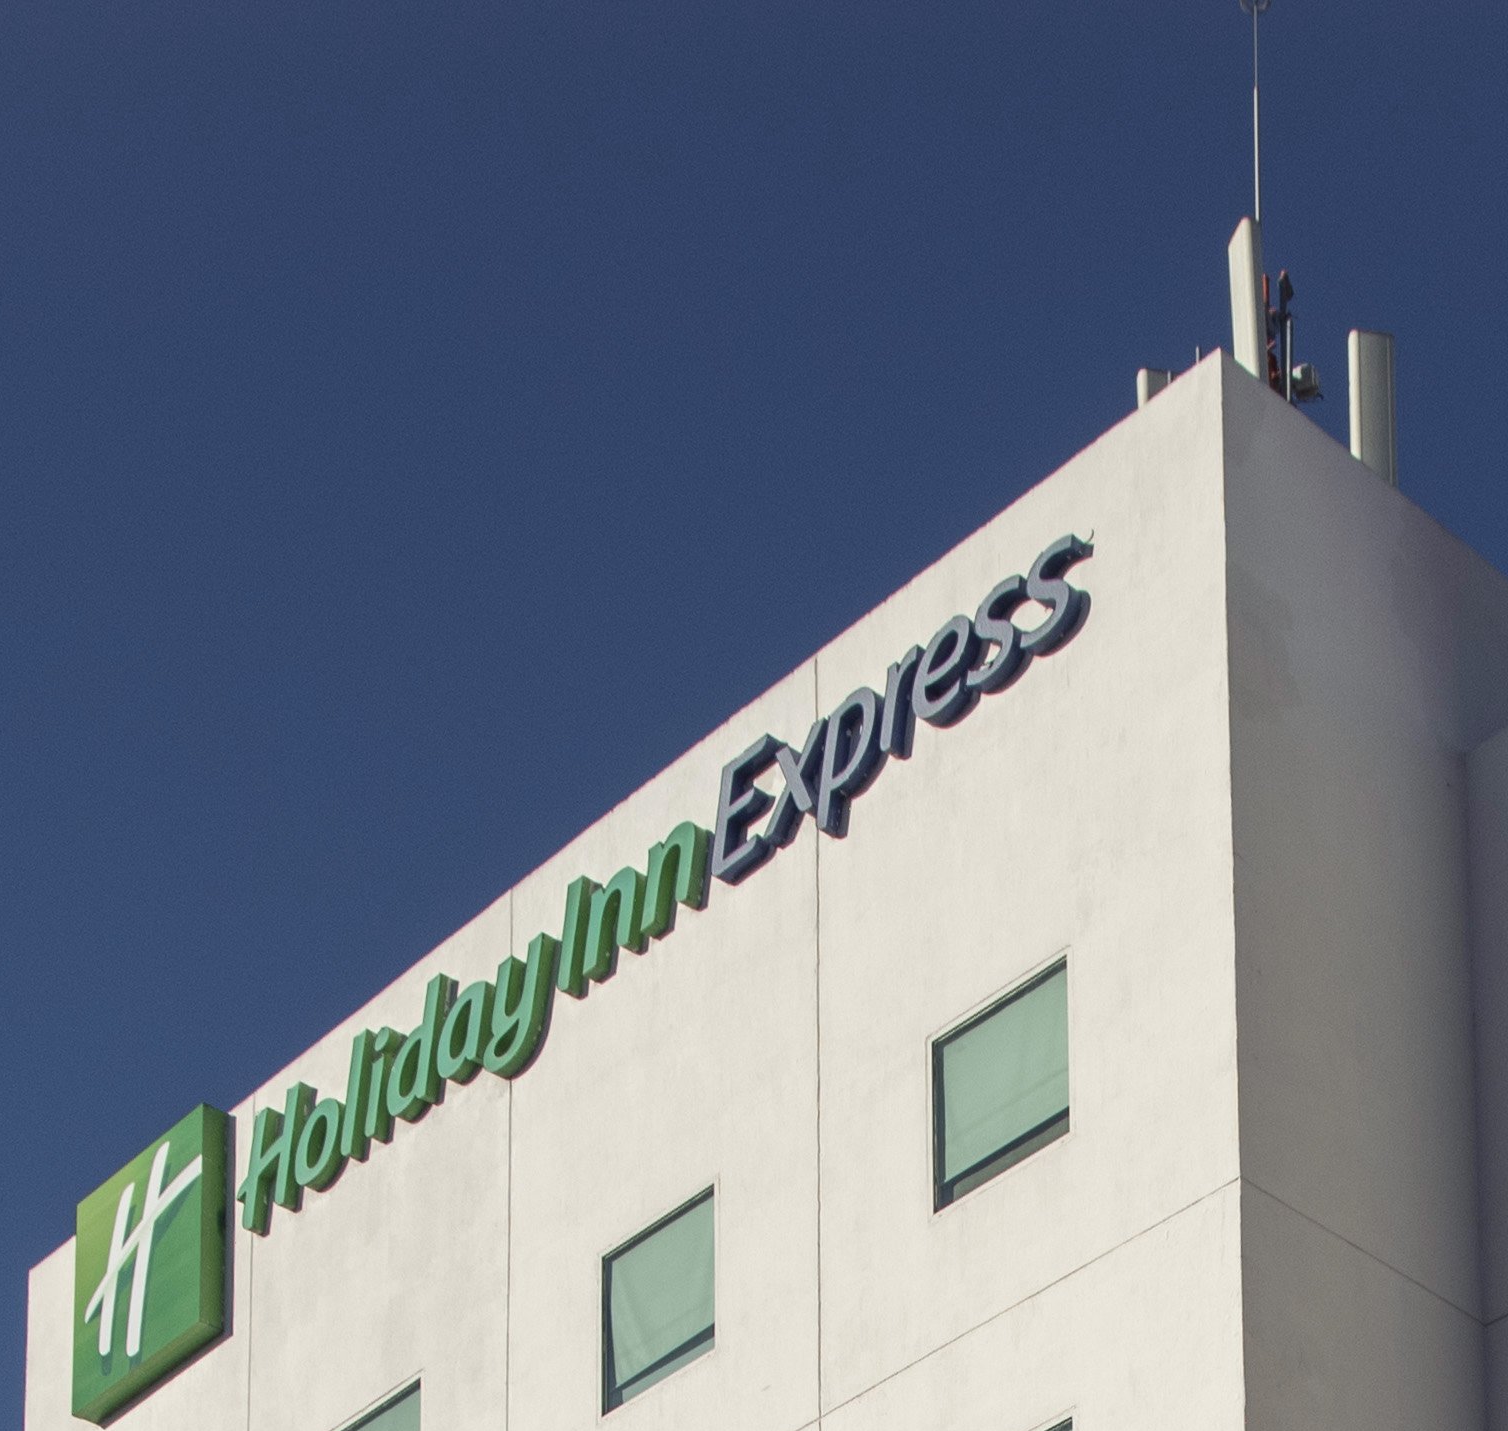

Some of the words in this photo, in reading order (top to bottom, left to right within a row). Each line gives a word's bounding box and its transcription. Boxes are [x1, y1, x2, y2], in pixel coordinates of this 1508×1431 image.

[238, 931, 561, 1237] Holiday
[556, 819, 713, 999] Inn
[711, 532, 1094, 886] Express
